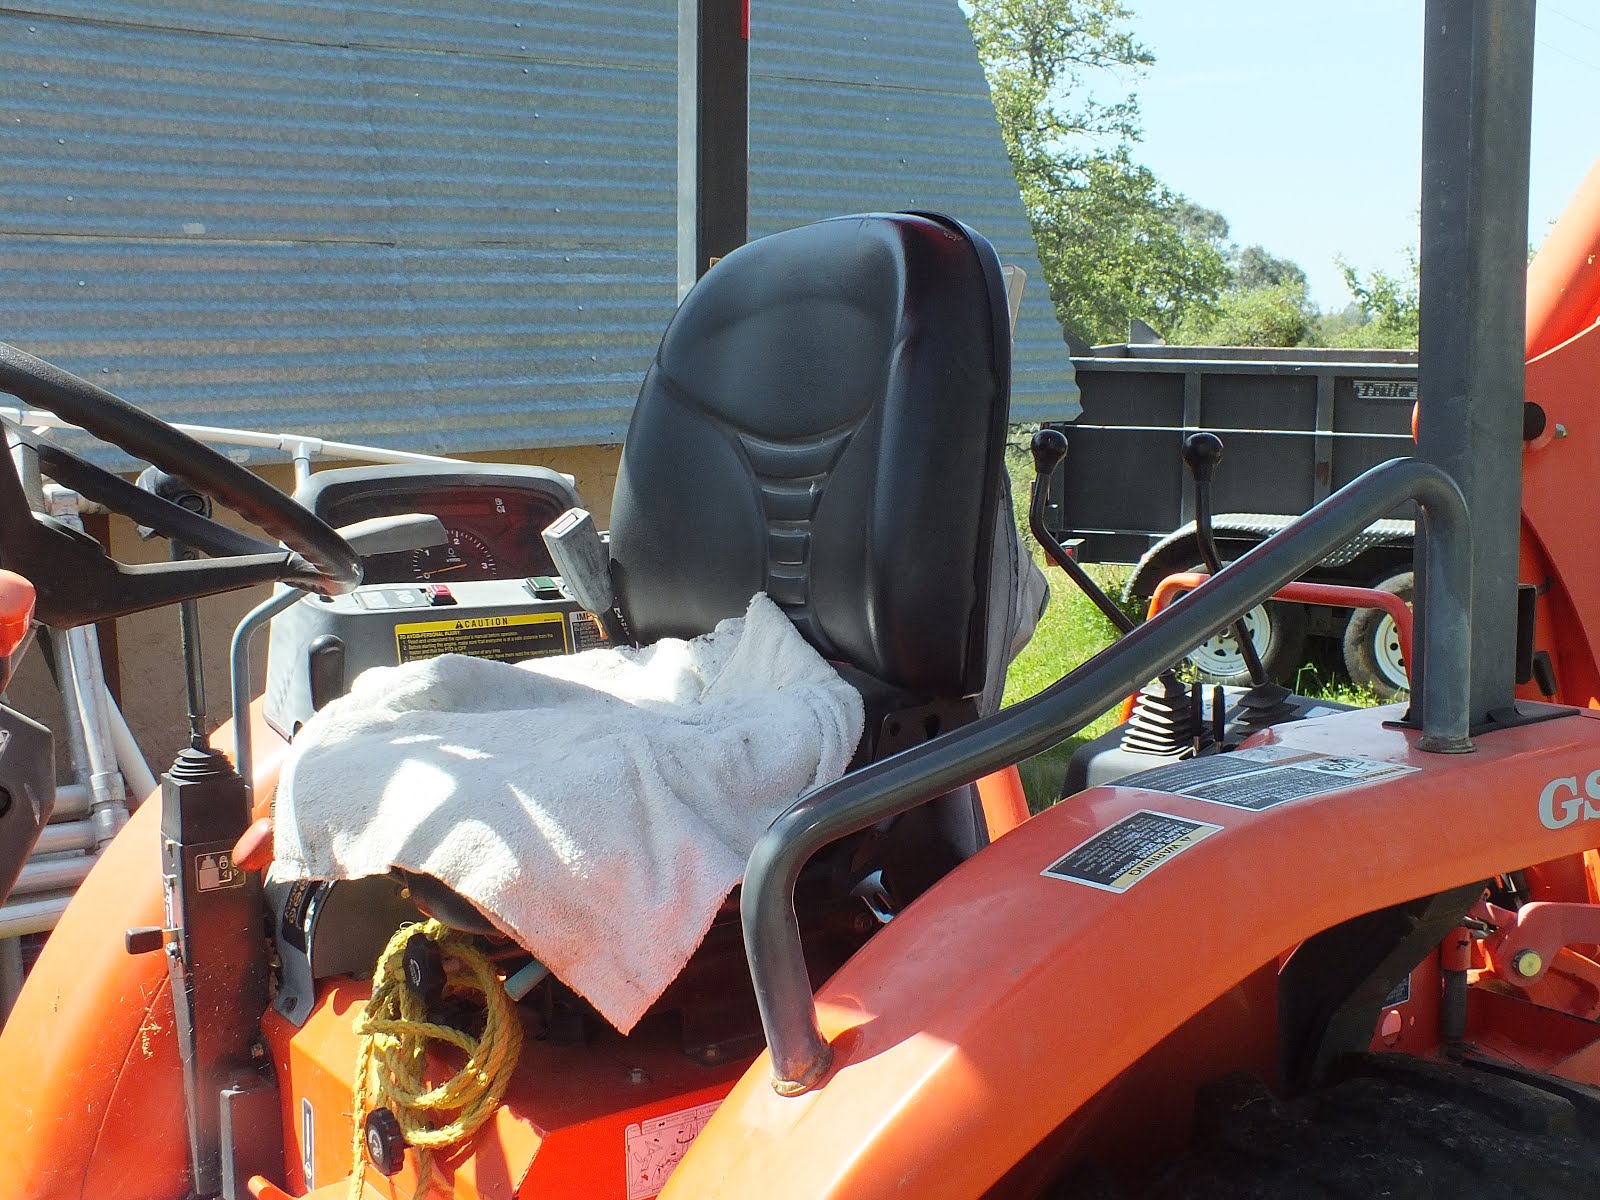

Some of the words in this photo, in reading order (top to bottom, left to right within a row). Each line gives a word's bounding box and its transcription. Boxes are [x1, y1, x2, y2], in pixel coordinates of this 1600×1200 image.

[424, 549, 431, 557] 1
[481, 562, 489, 570] 3
[464, 617, 508, 629] CAUTION
[1127, 843, 1182, 877] WARNING
